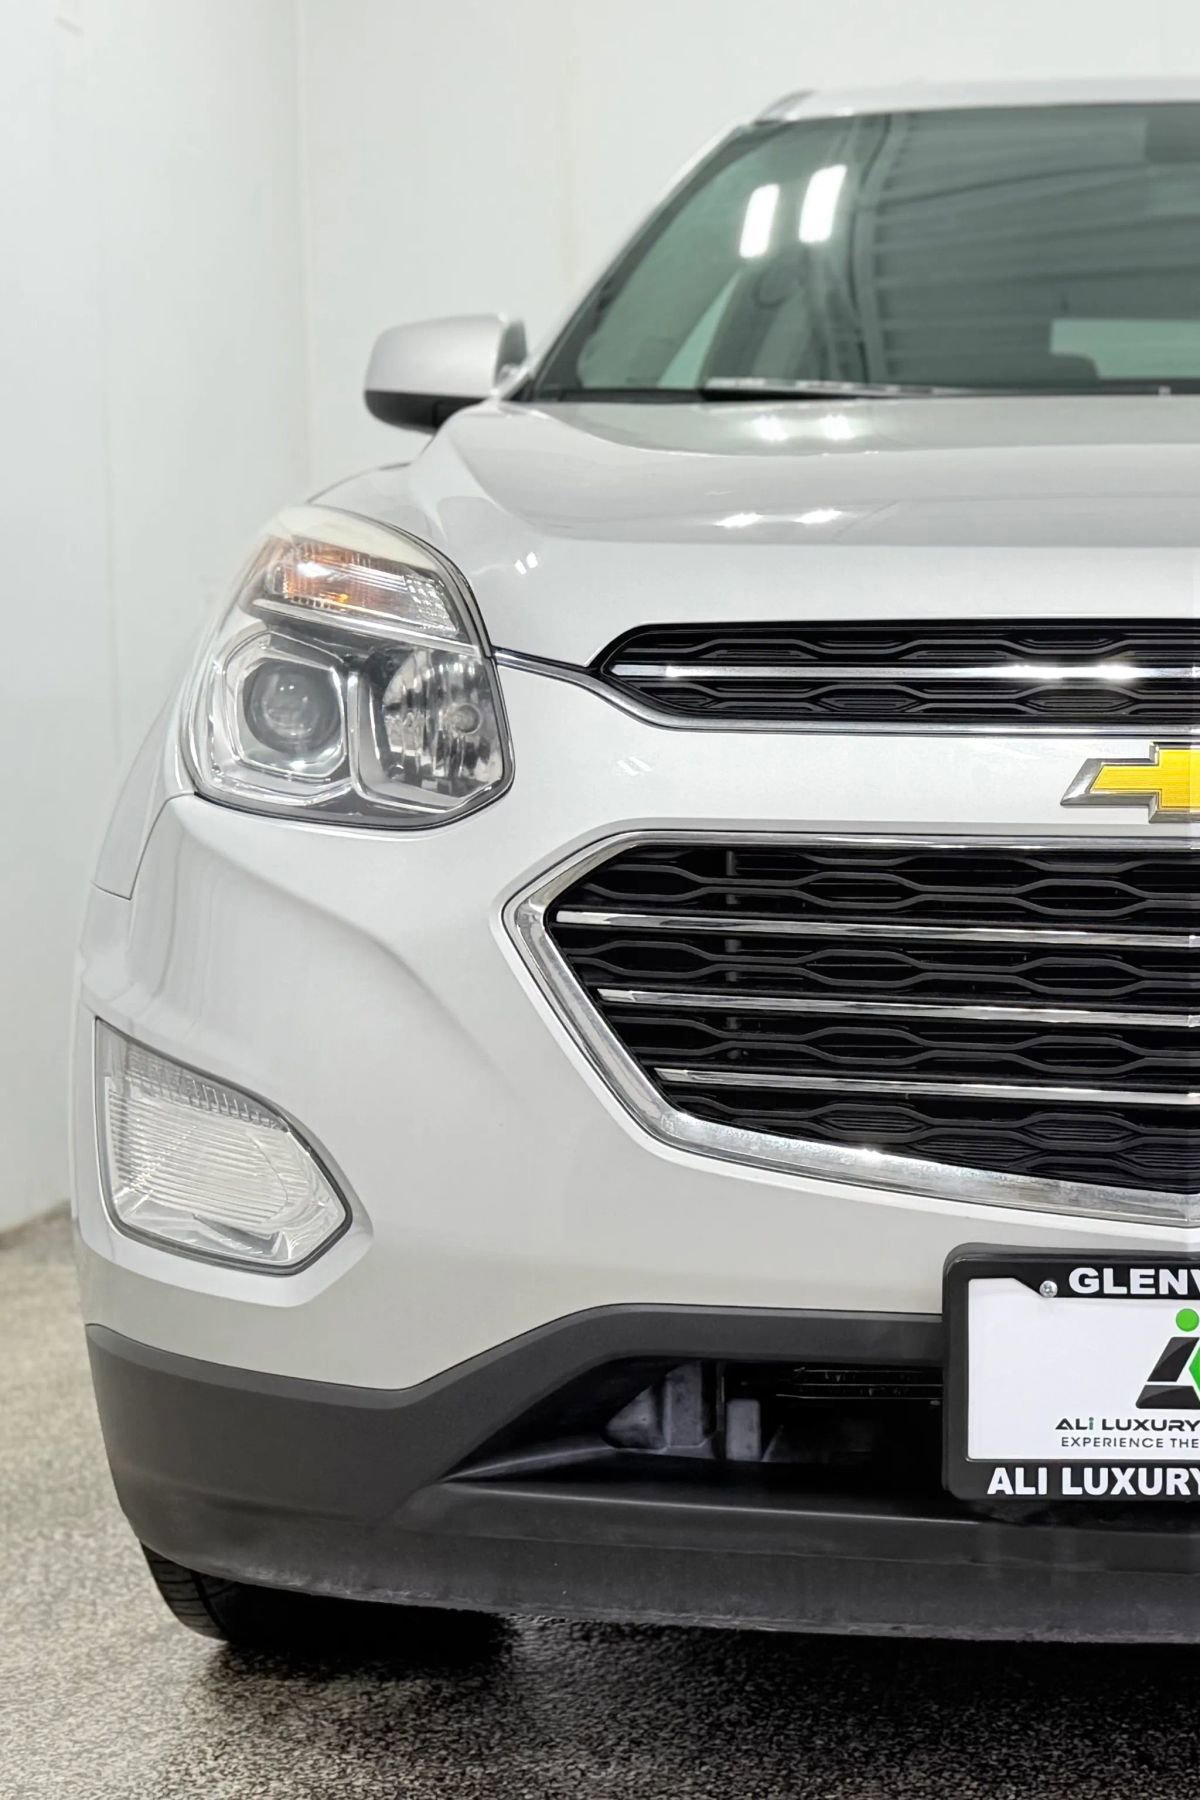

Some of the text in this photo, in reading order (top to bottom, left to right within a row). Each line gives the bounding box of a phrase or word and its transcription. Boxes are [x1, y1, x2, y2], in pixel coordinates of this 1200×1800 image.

[1061, 1436, 1164, 1449] EXPERIENCE
[1169, 1437, 1200, 1449] THE
[986, 1467, 1048, 1495] ALI
